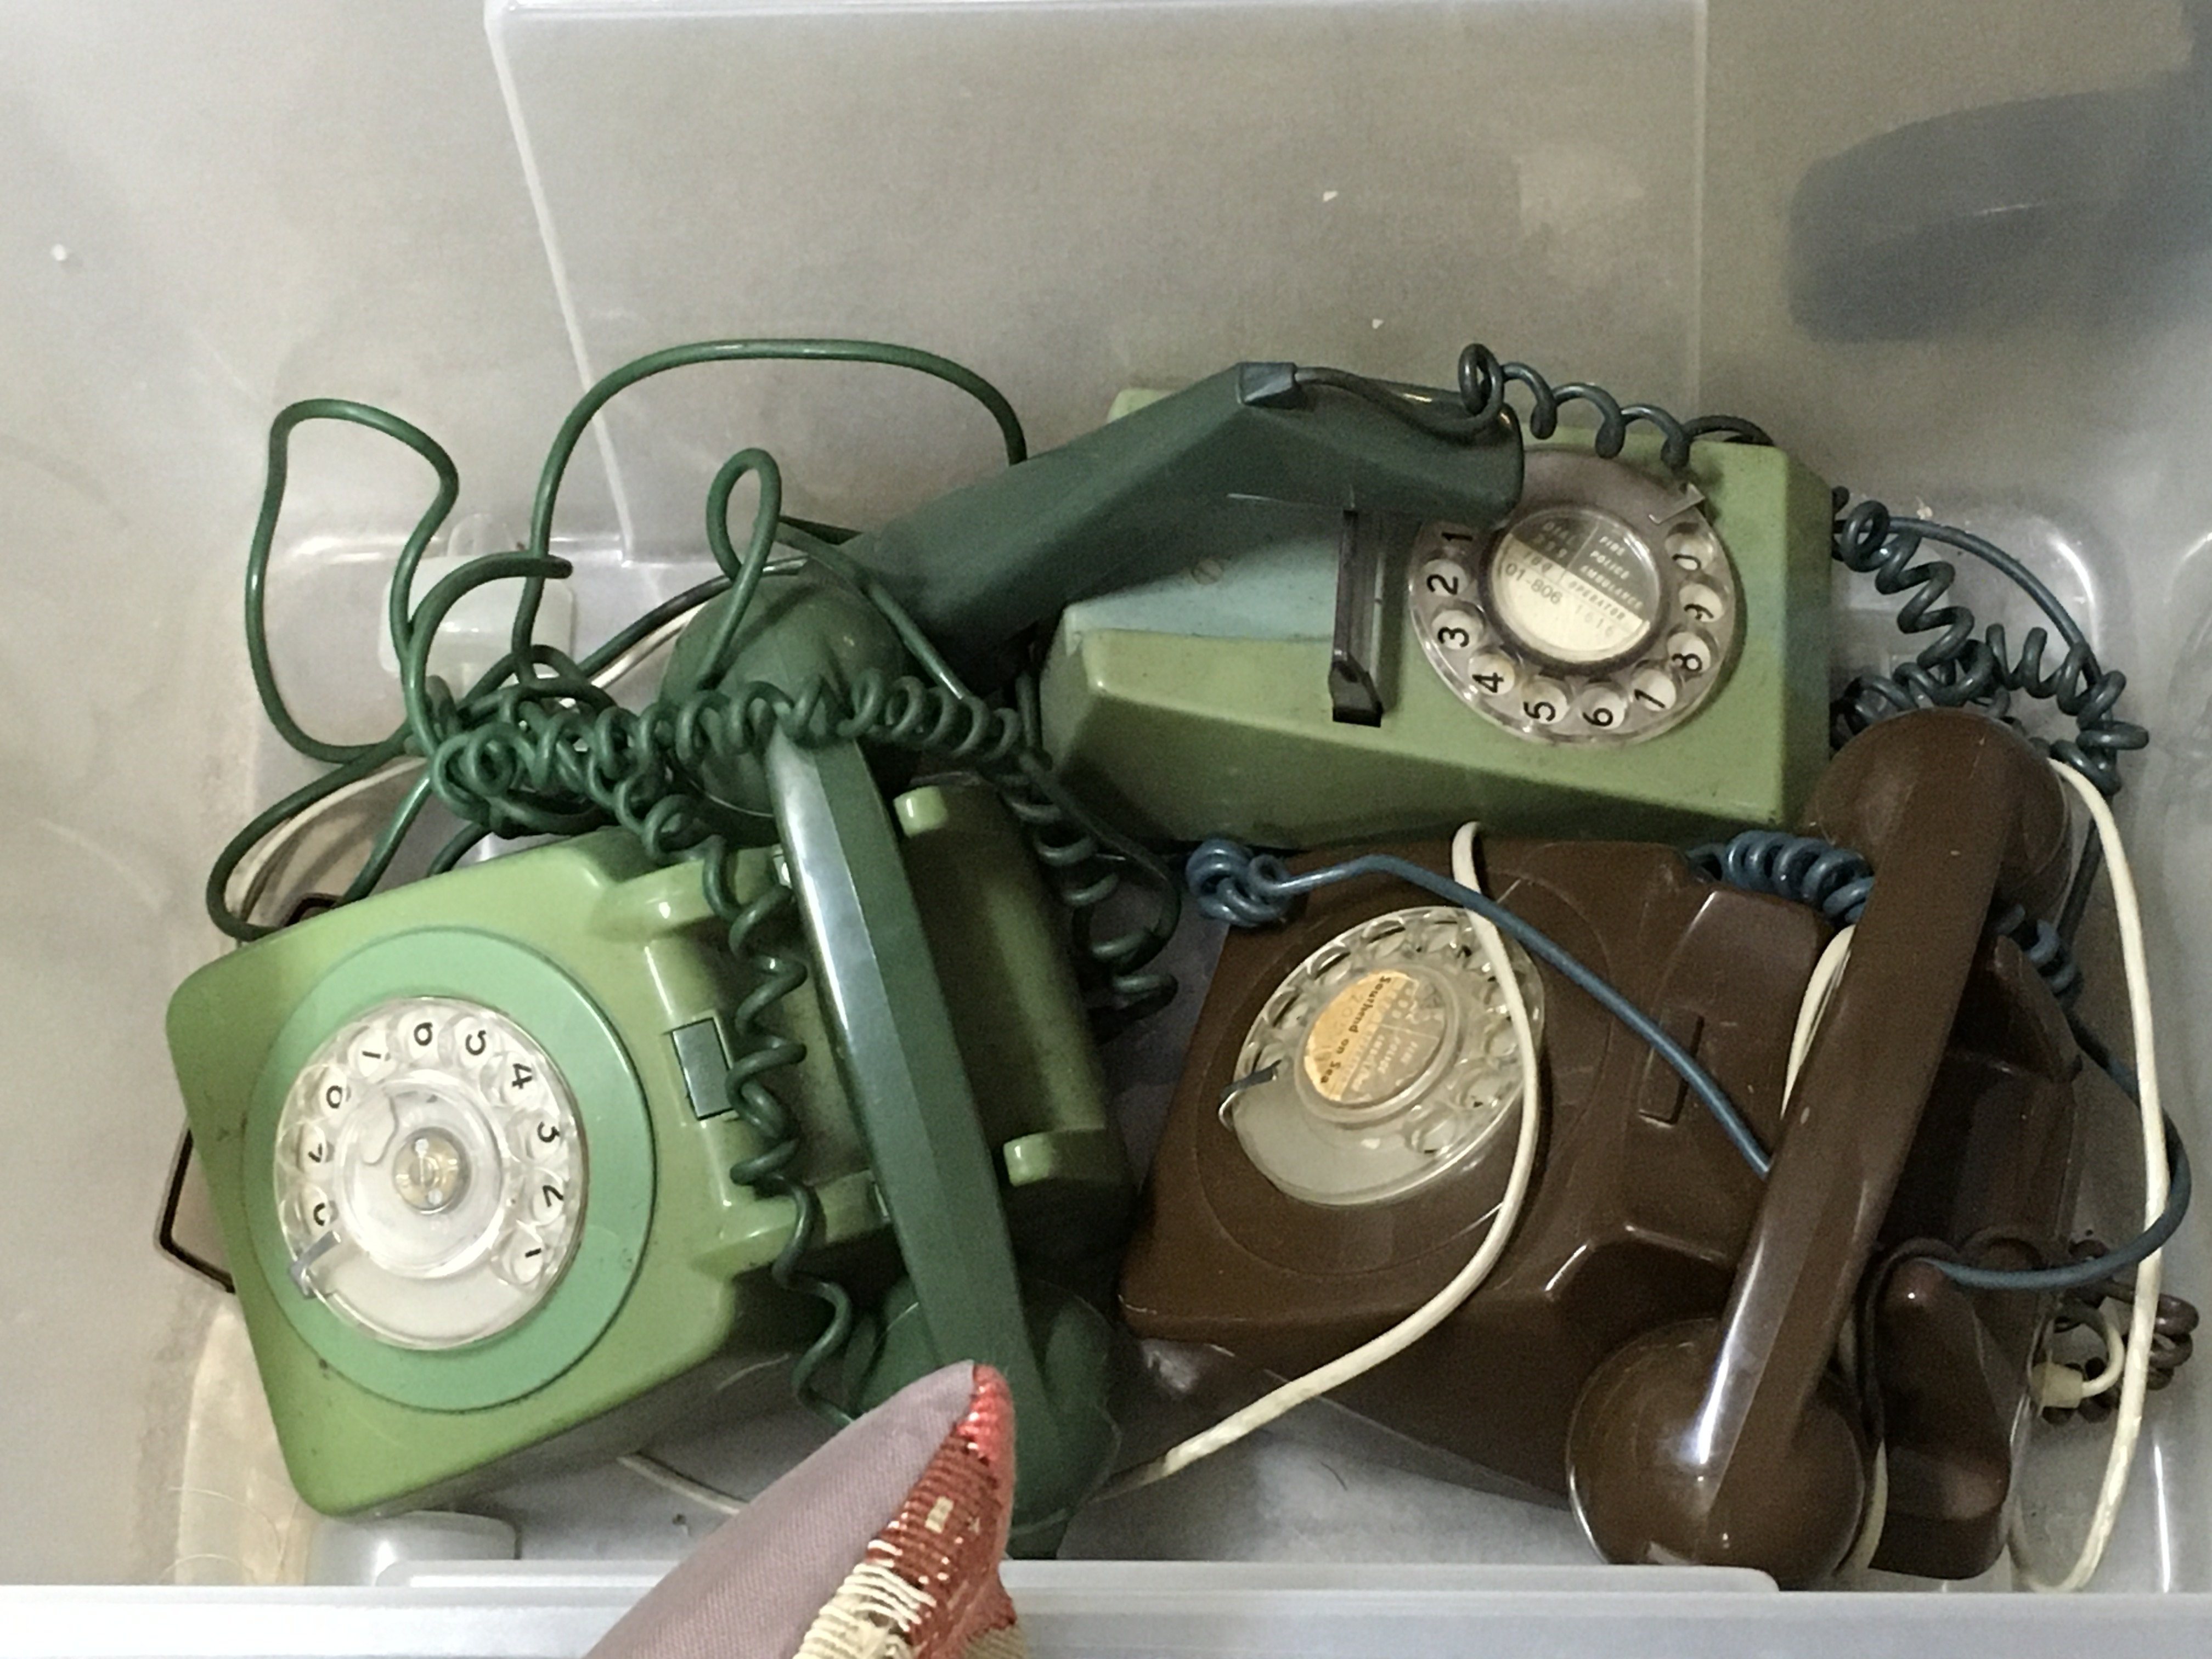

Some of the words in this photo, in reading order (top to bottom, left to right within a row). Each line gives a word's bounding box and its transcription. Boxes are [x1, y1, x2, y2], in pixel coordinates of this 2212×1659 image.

[1441, 532, 1474, 541] 1
[1599, 536, 1626, 556] FIRE
[1590, 550, 1630, 579] POLICE
[1426, 573, 1459, 595] 2
[1505, 562, 1563, 605] 01-806
[1580, 565, 1644, 610] AMBULANCE
[1568, 580, 1626, 620] OPERATOR
[1437, 626, 1470, 648] 3
[1472, 672, 1504, 693] 4
[1523, 701, 1556, 722] 5
[1582, 707, 1613, 727] 6
[465, 1030, 487, 1056] 5
[1336, 1039, 1350, 1054] on
[511, 1063, 533, 1090] 4
[1320, 1060, 1341, 1084] Sea
[524, 1248, 542, 1258] 1
